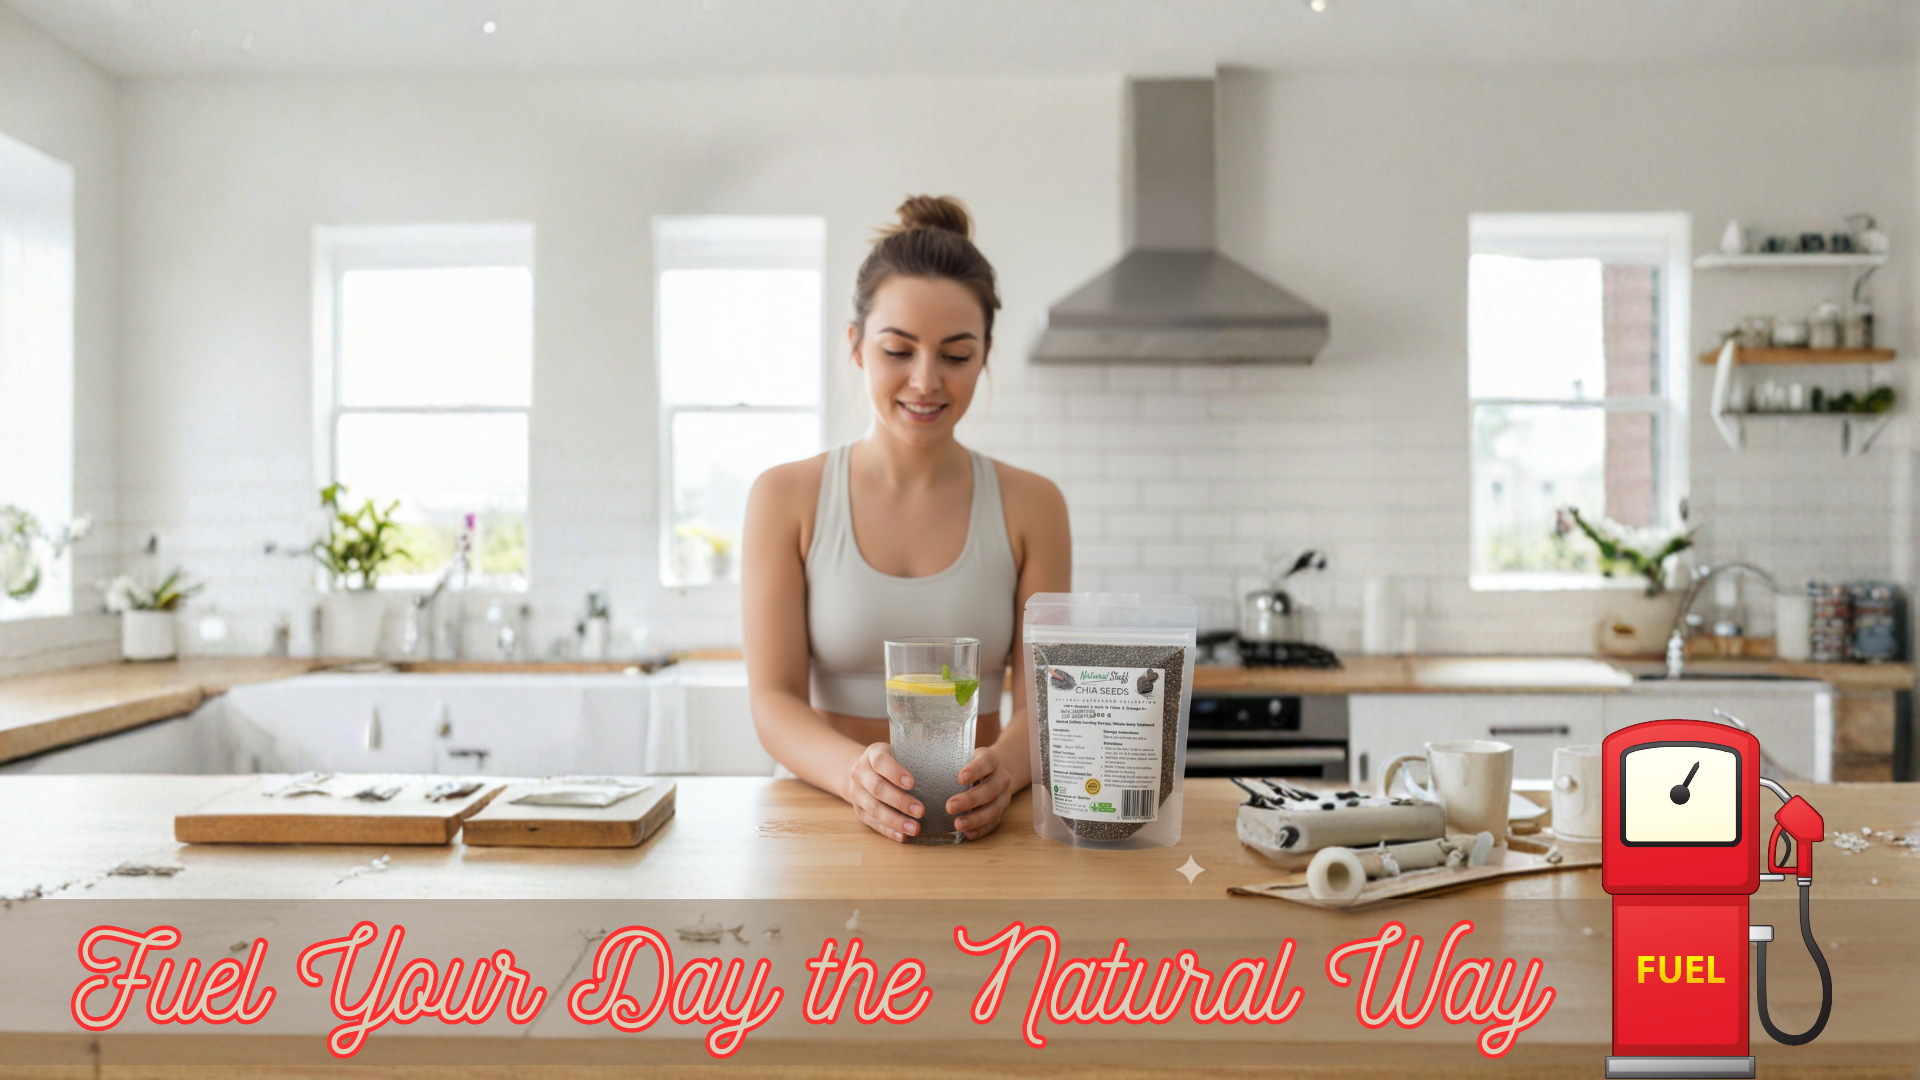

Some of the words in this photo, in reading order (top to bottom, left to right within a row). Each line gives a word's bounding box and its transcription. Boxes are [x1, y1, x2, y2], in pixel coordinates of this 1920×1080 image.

[1110, 671, 1129, 684] Stuff
[1075, 686, 1097, 695] CHIA
[1100, 687, 1129, 696] SEEDS
